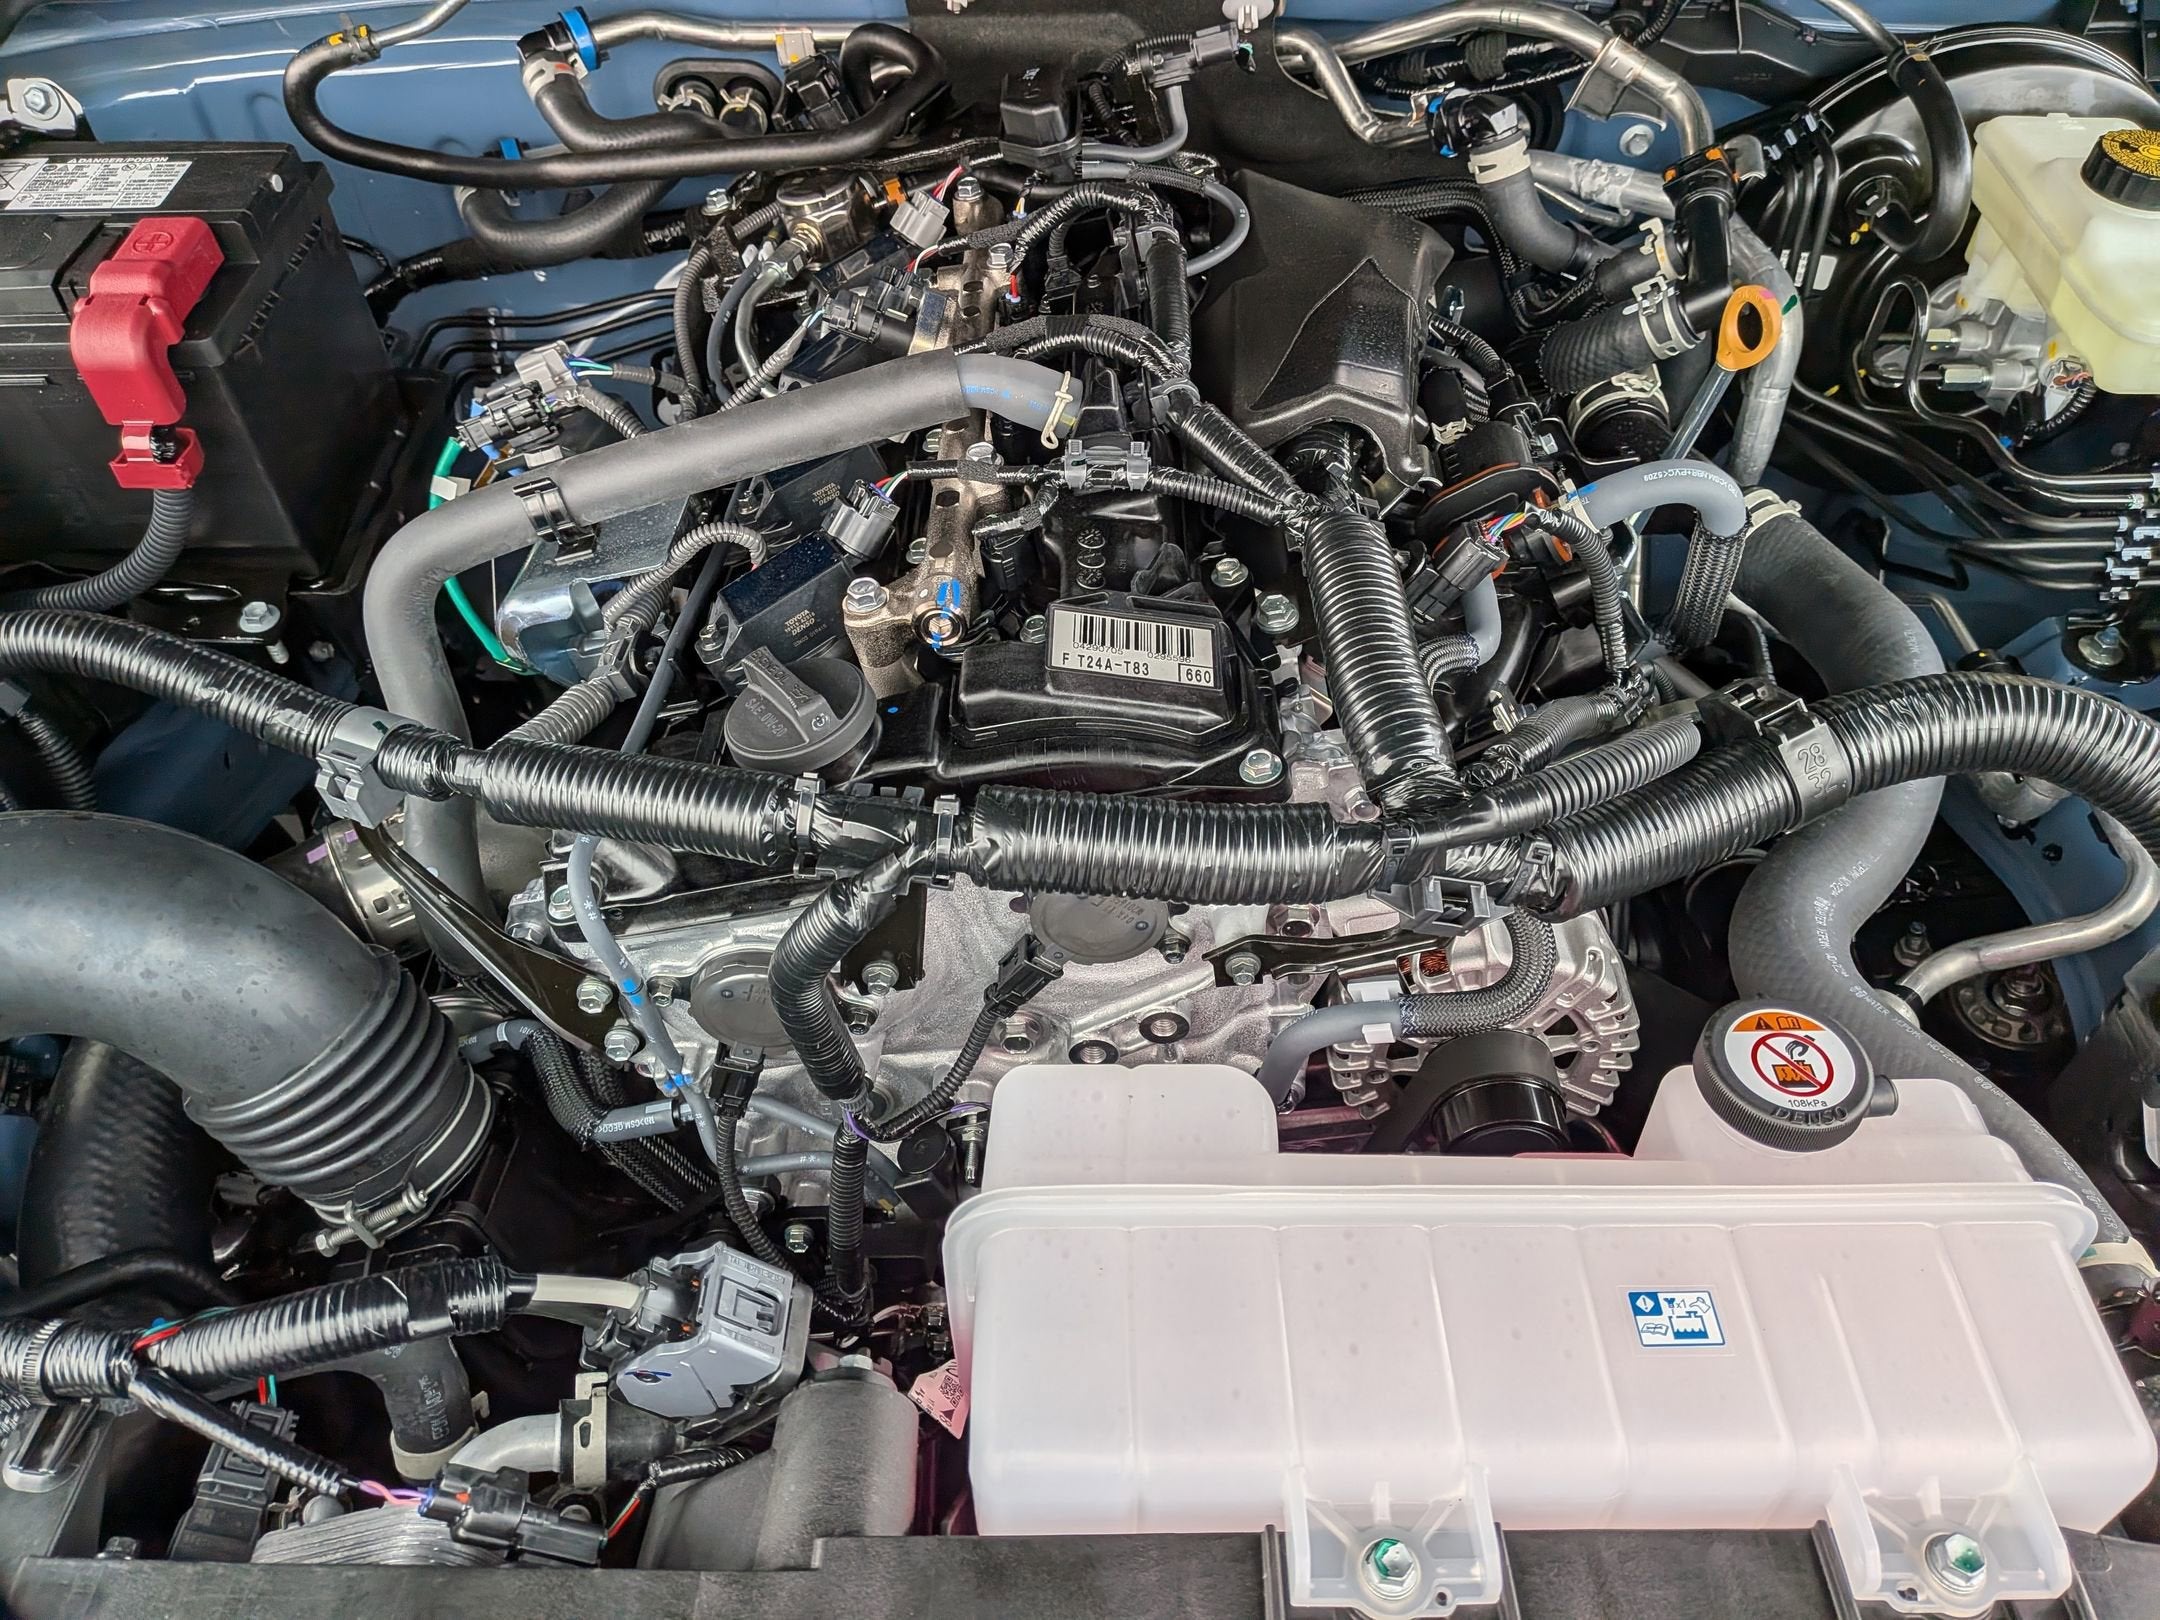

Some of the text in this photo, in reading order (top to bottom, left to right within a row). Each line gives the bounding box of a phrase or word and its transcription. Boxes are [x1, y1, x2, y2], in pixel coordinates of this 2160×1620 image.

[812, 482, 838, 498] TOYOTA
[818, 490, 841, 506] DENSO
[784, 609, 810, 627] TOYOTA
[791, 618, 816, 636] DENSO
[1147, 651, 1192, 663] 0295596
[1062, 652, 1212, 684] F T24A-T83 660
[744, 698, 763, 716] SAE
[1797, 742, 1828, 775] 28
[1864, 995, 1891, 1016] WATER
[1787, 1099, 1829, 1109] 108kPa
